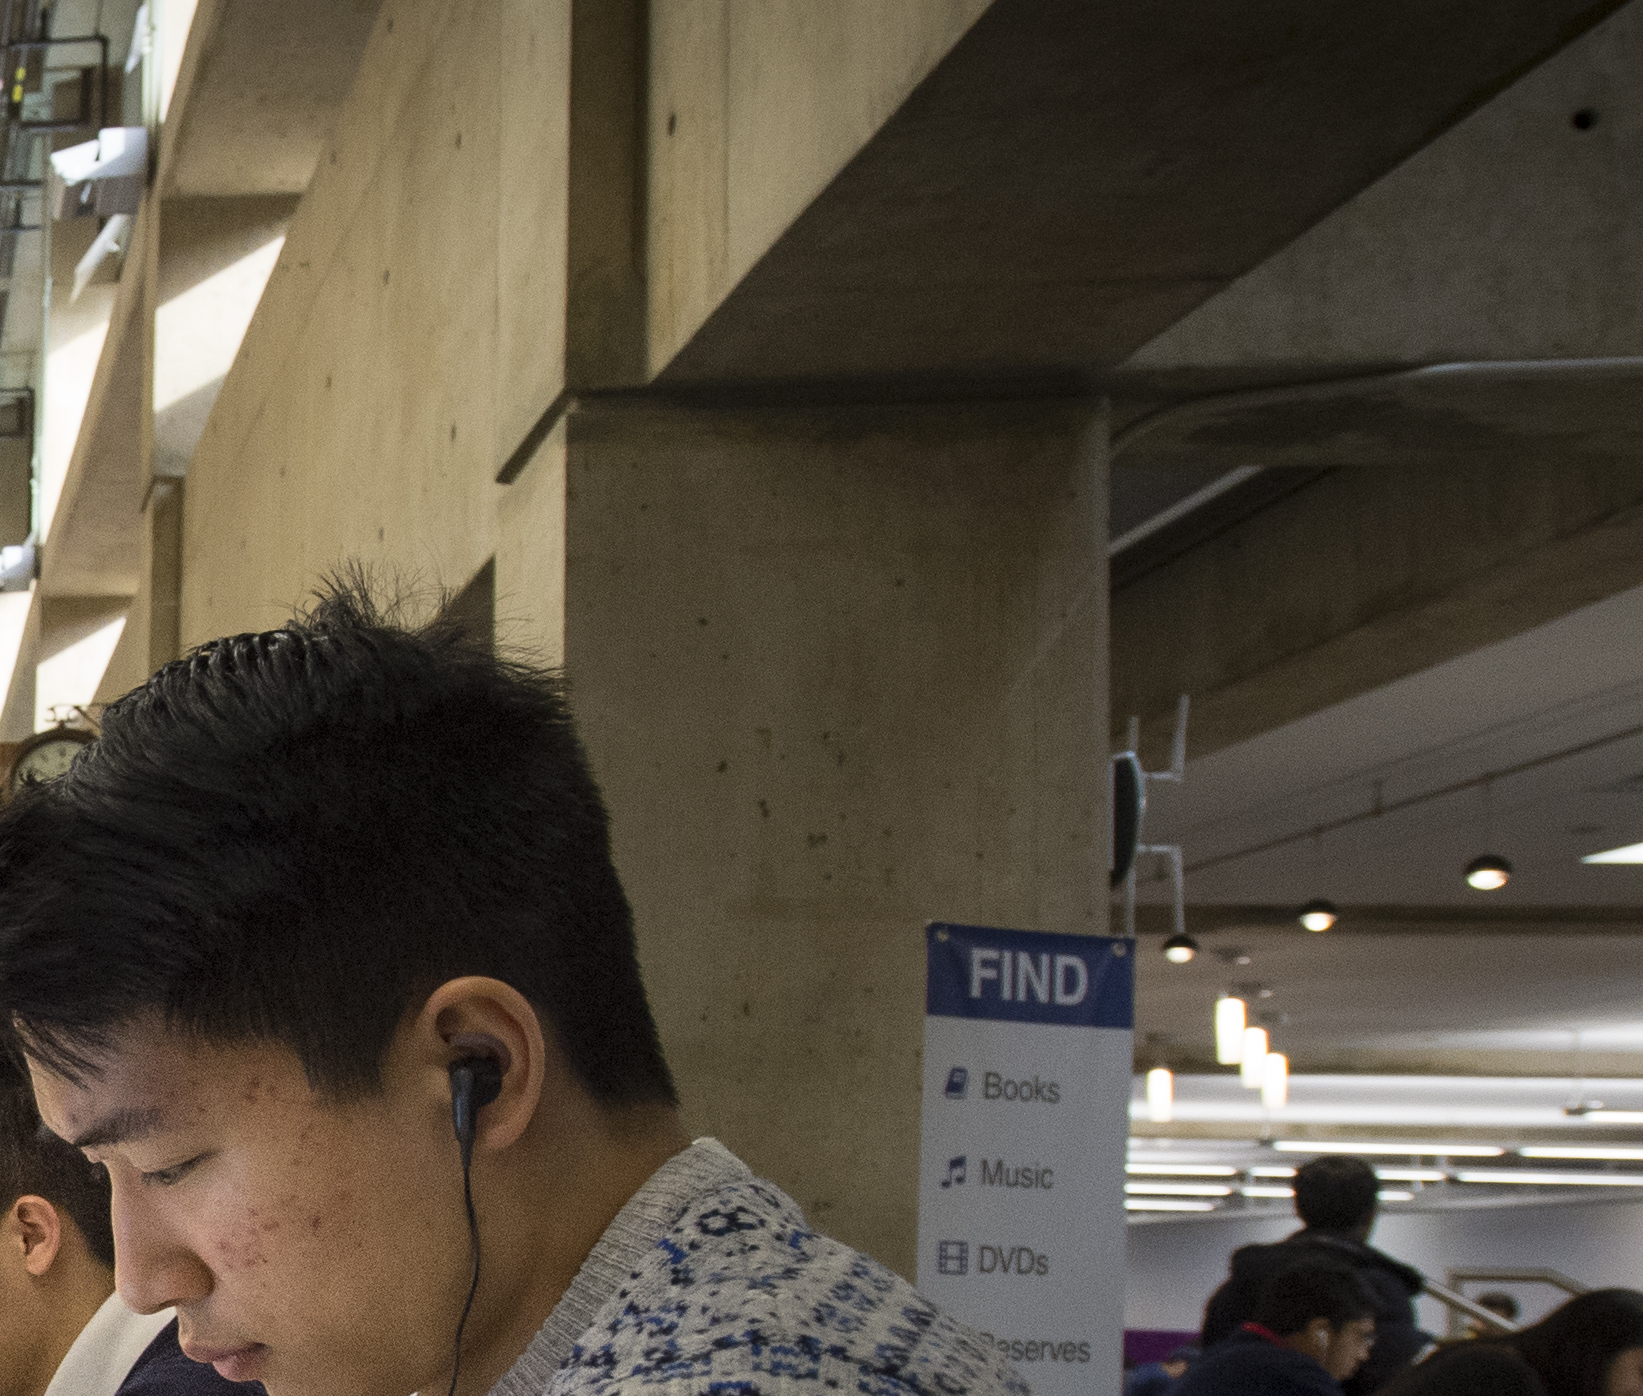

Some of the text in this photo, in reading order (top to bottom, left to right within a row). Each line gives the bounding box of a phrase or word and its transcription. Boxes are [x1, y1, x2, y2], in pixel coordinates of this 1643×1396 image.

[969, 947, 1088, 1007] FIND
[984, 1071, 1061, 1103] Books
[981, 1159, 1054, 1189] Music
[978, 1245, 1049, 1276] DVDs
